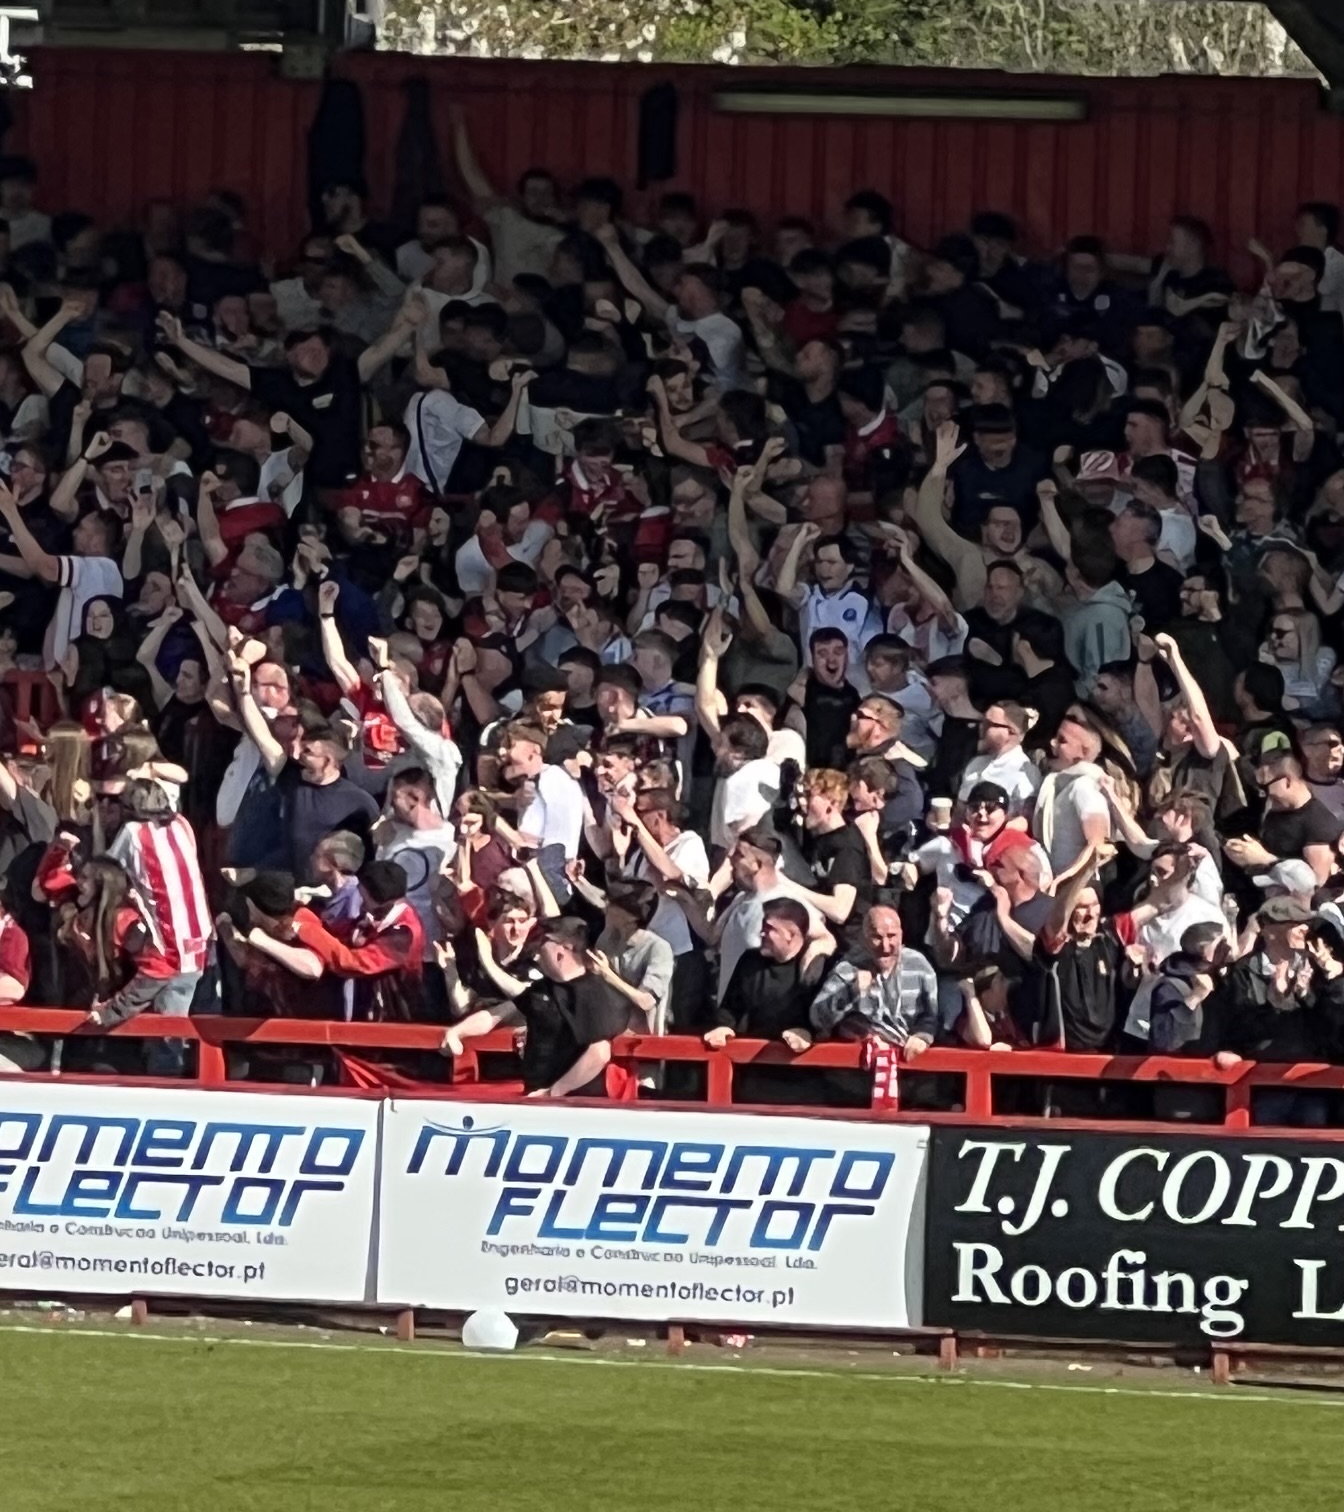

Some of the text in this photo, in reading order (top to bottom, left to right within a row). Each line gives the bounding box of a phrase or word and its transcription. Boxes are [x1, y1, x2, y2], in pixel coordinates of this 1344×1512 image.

[953, 1139, 1344, 1236] T.J. COPP
[950, 1242, 1249, 1338] Roofing
